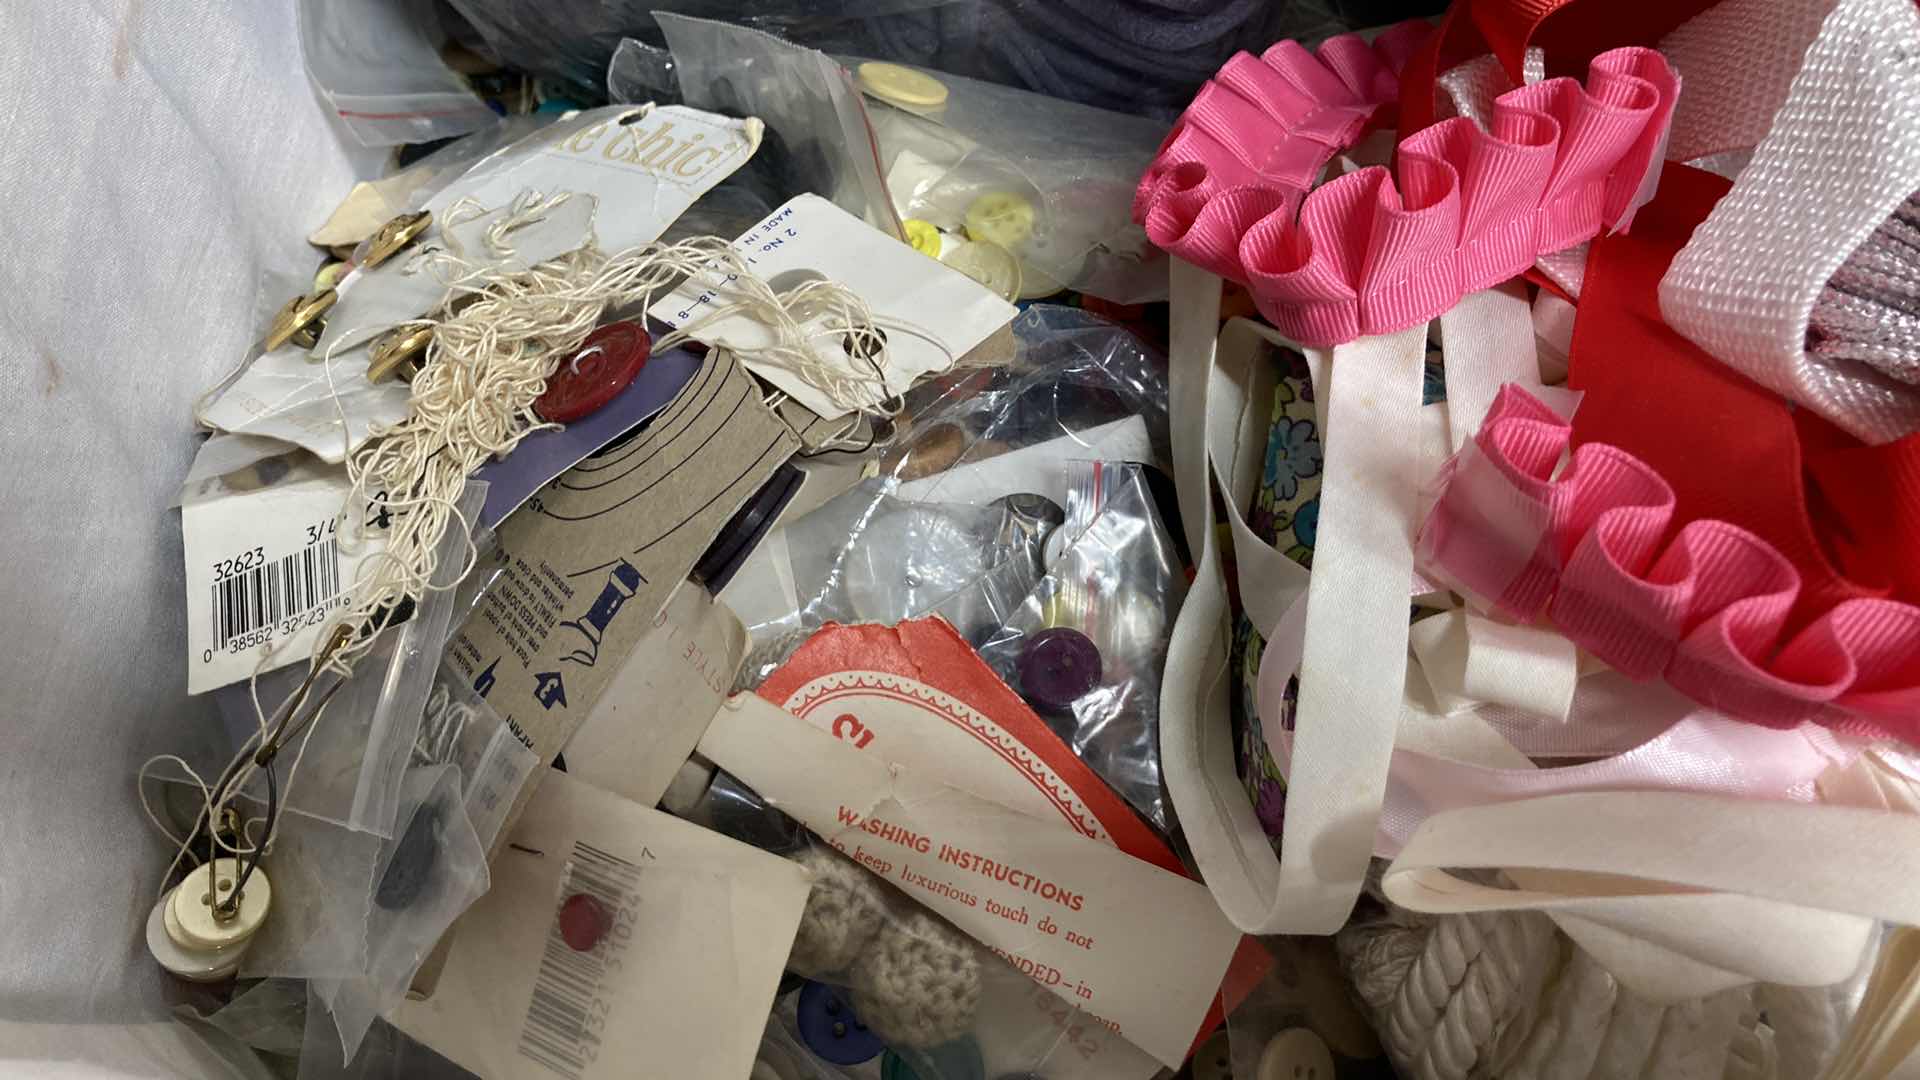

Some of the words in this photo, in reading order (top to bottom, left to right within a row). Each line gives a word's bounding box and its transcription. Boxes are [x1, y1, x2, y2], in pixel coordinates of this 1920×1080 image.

[761, 206, 793, 233] MADE
[743, 233, 760, 246] IN
[212, 546, 266, 583] 32623
[203, 649, 213, 664] 0
[229, 626, 274, 655] 38562
[836, 805, 931, 854] WASHING
[938, 844, 1085, 912] INSTRUCTIONS
[853, 844, 893, 874] keep
[901, 864, 978, 908] luxurious
[985, 899, 1030, 925] touch
[1037, 915, 1059, 936] do
[1065, 930, 1095, 951] not
